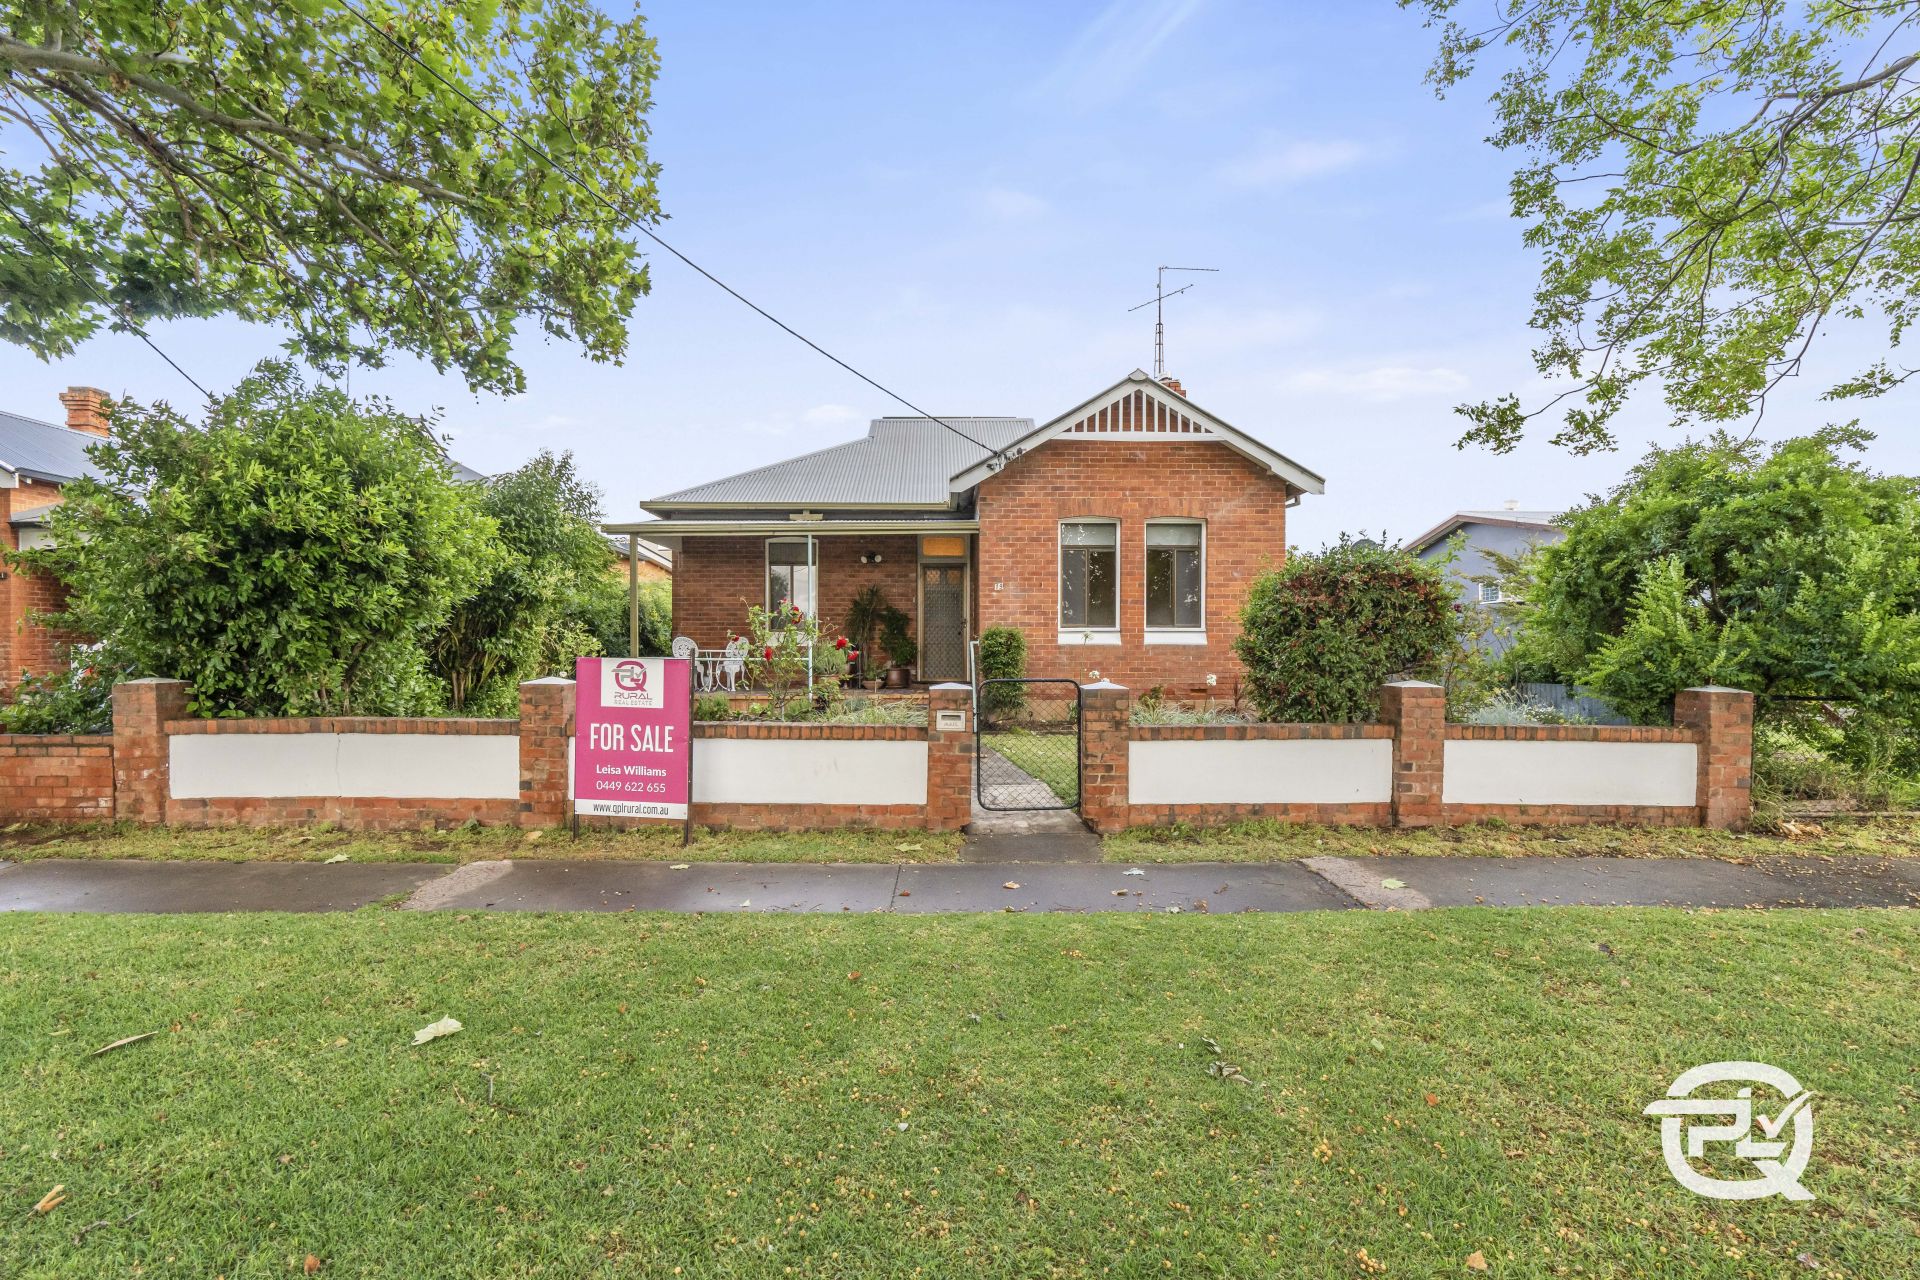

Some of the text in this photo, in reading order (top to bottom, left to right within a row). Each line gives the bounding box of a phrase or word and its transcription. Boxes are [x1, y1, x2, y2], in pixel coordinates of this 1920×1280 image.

[614, 692, 653, 700] RURAL
[590, 723, 674, 753] FOR SALE
[596, 764, 667, 777] Leisa Williams
[596, 781, 666, 793] 0449 622 655
[593, 802, 669, 816] www.qplrural.com.au
